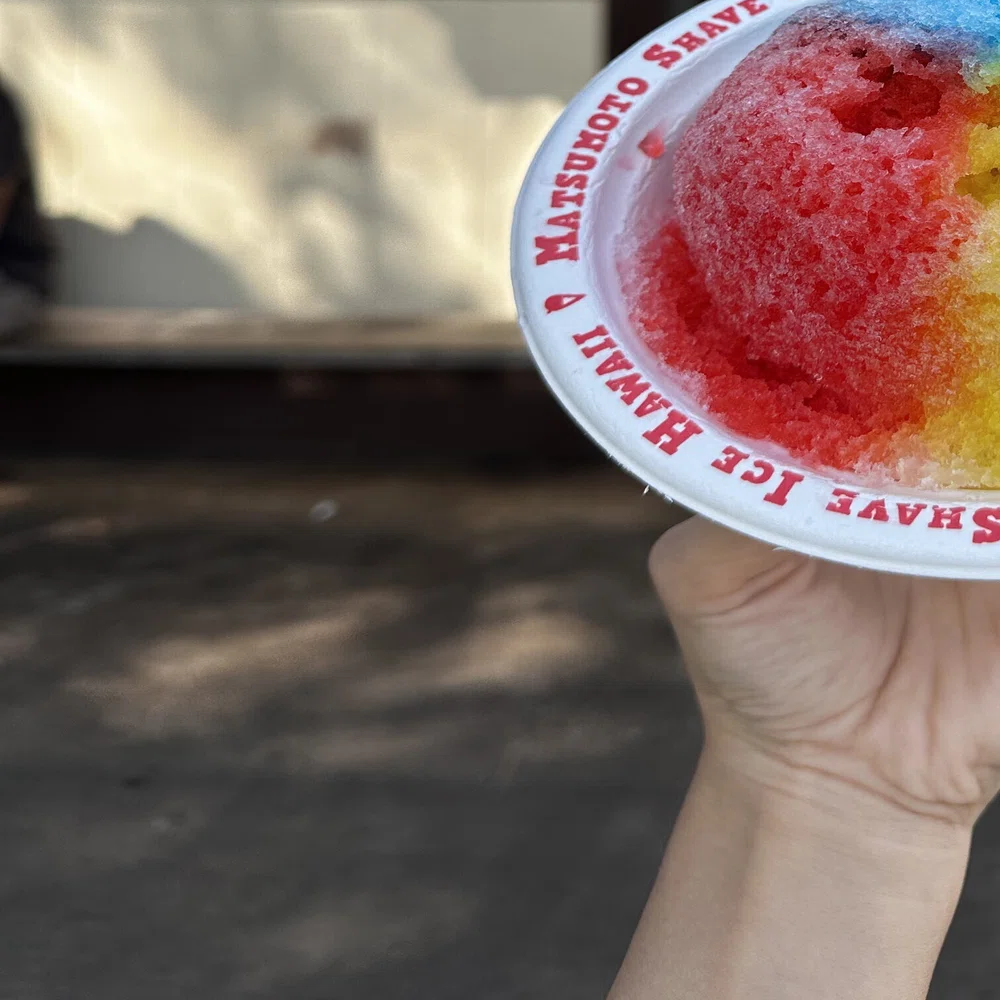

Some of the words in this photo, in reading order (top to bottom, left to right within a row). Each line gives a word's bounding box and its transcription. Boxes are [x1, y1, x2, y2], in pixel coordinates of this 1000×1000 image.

[534, 76, 649, 266] MATSUMOTO
[572, 325, 704, 456] HAWAII
[710, 445, 805, 507] ICE
